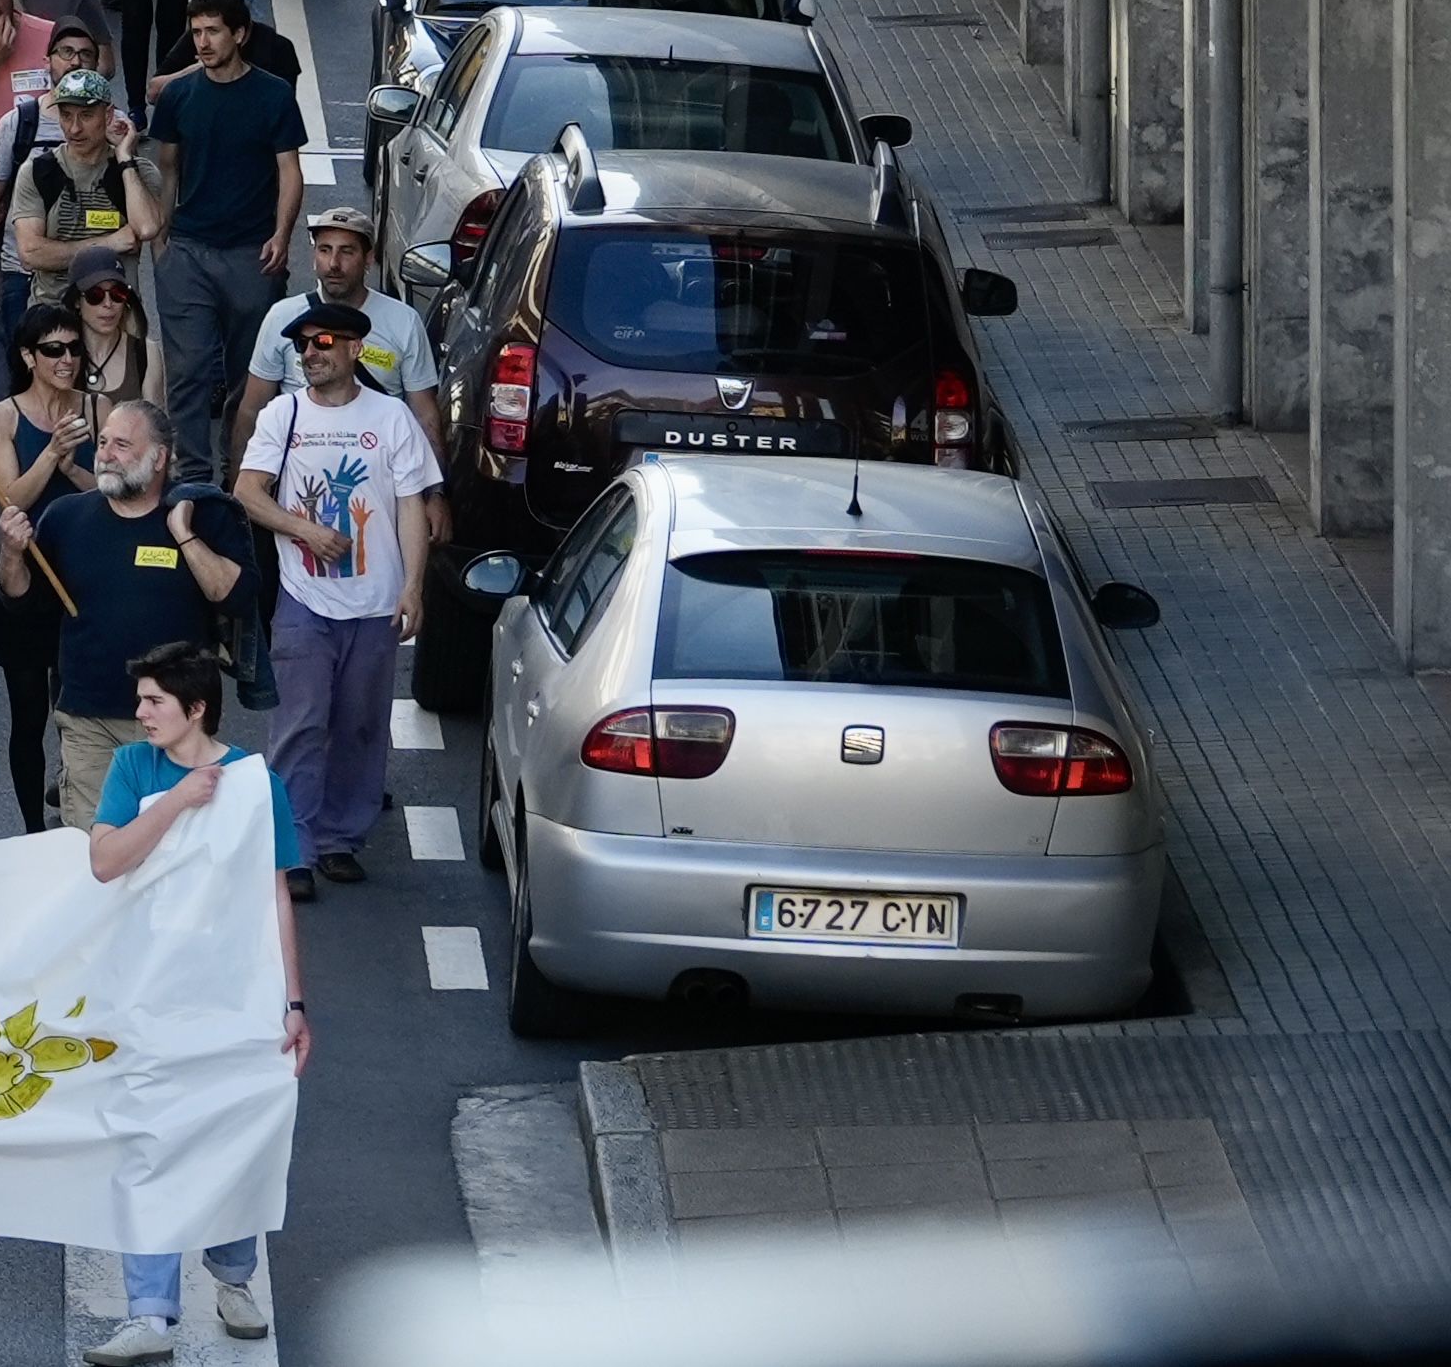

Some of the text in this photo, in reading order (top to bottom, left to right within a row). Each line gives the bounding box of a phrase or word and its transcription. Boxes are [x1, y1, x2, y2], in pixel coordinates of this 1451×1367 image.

[665, 430, 798, 451] DUSTER
[777, 896, 871, 931] 6727
[882, 901, 948, 936] CYN
